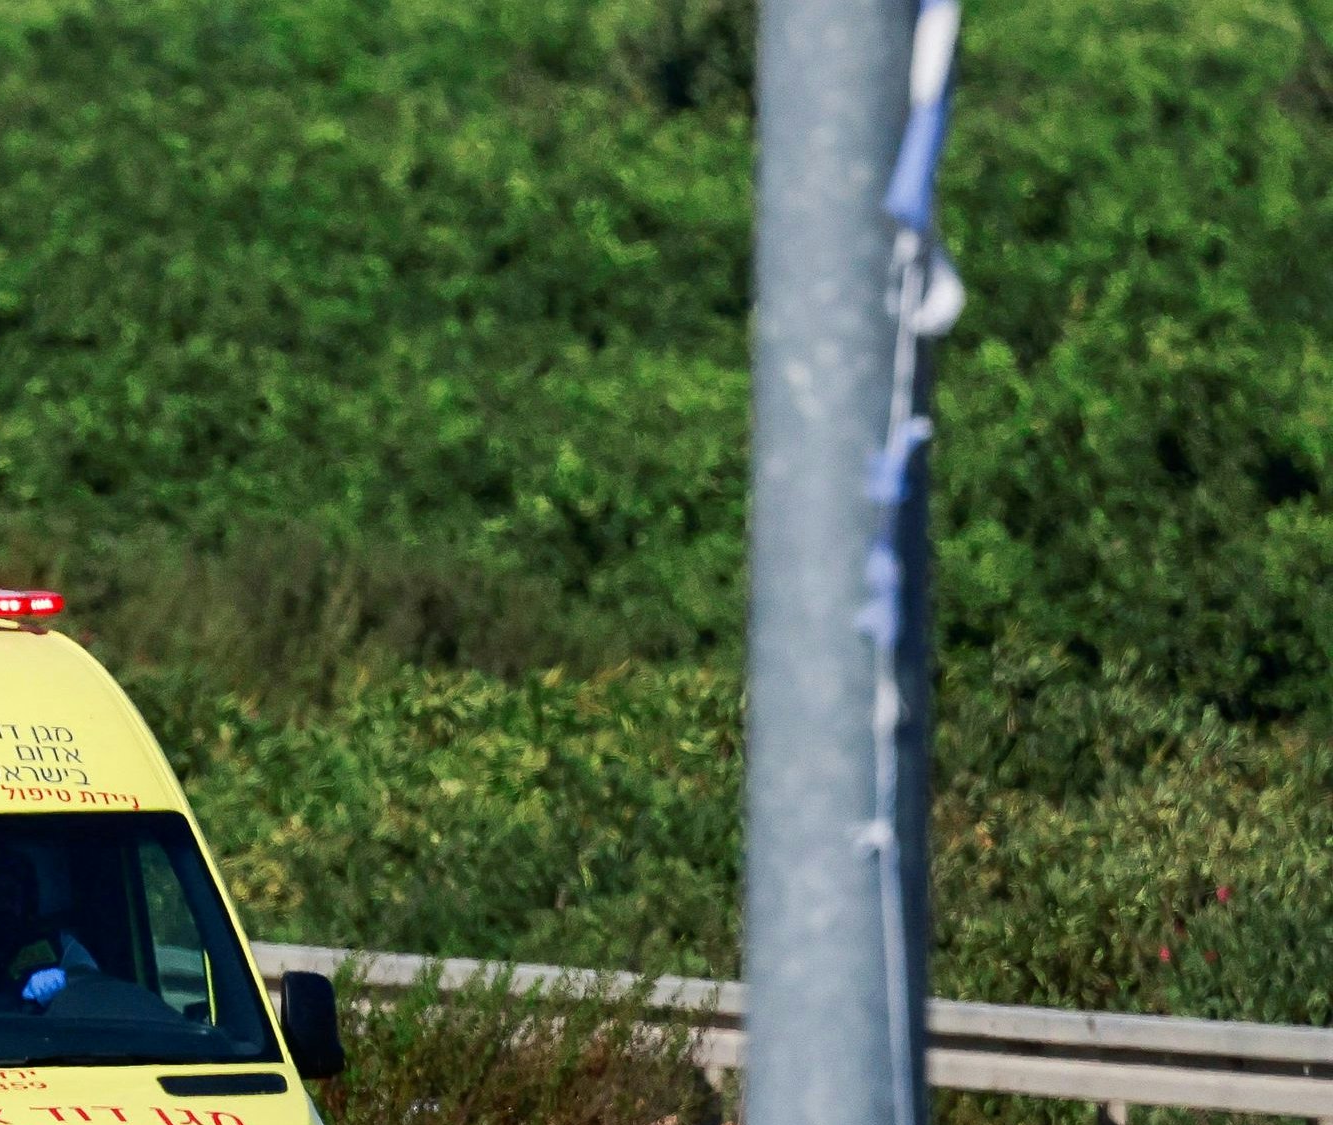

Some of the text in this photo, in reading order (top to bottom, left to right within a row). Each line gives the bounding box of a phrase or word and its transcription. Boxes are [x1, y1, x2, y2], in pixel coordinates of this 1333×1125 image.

[30, 725, 73, 744] מגן
[15, 744, 83, 763] אדום
[0, 784, 71, 802] טיפול
[78, 790, 140, 812] ניידת
[28, 1105, 128, 1123] דוד
